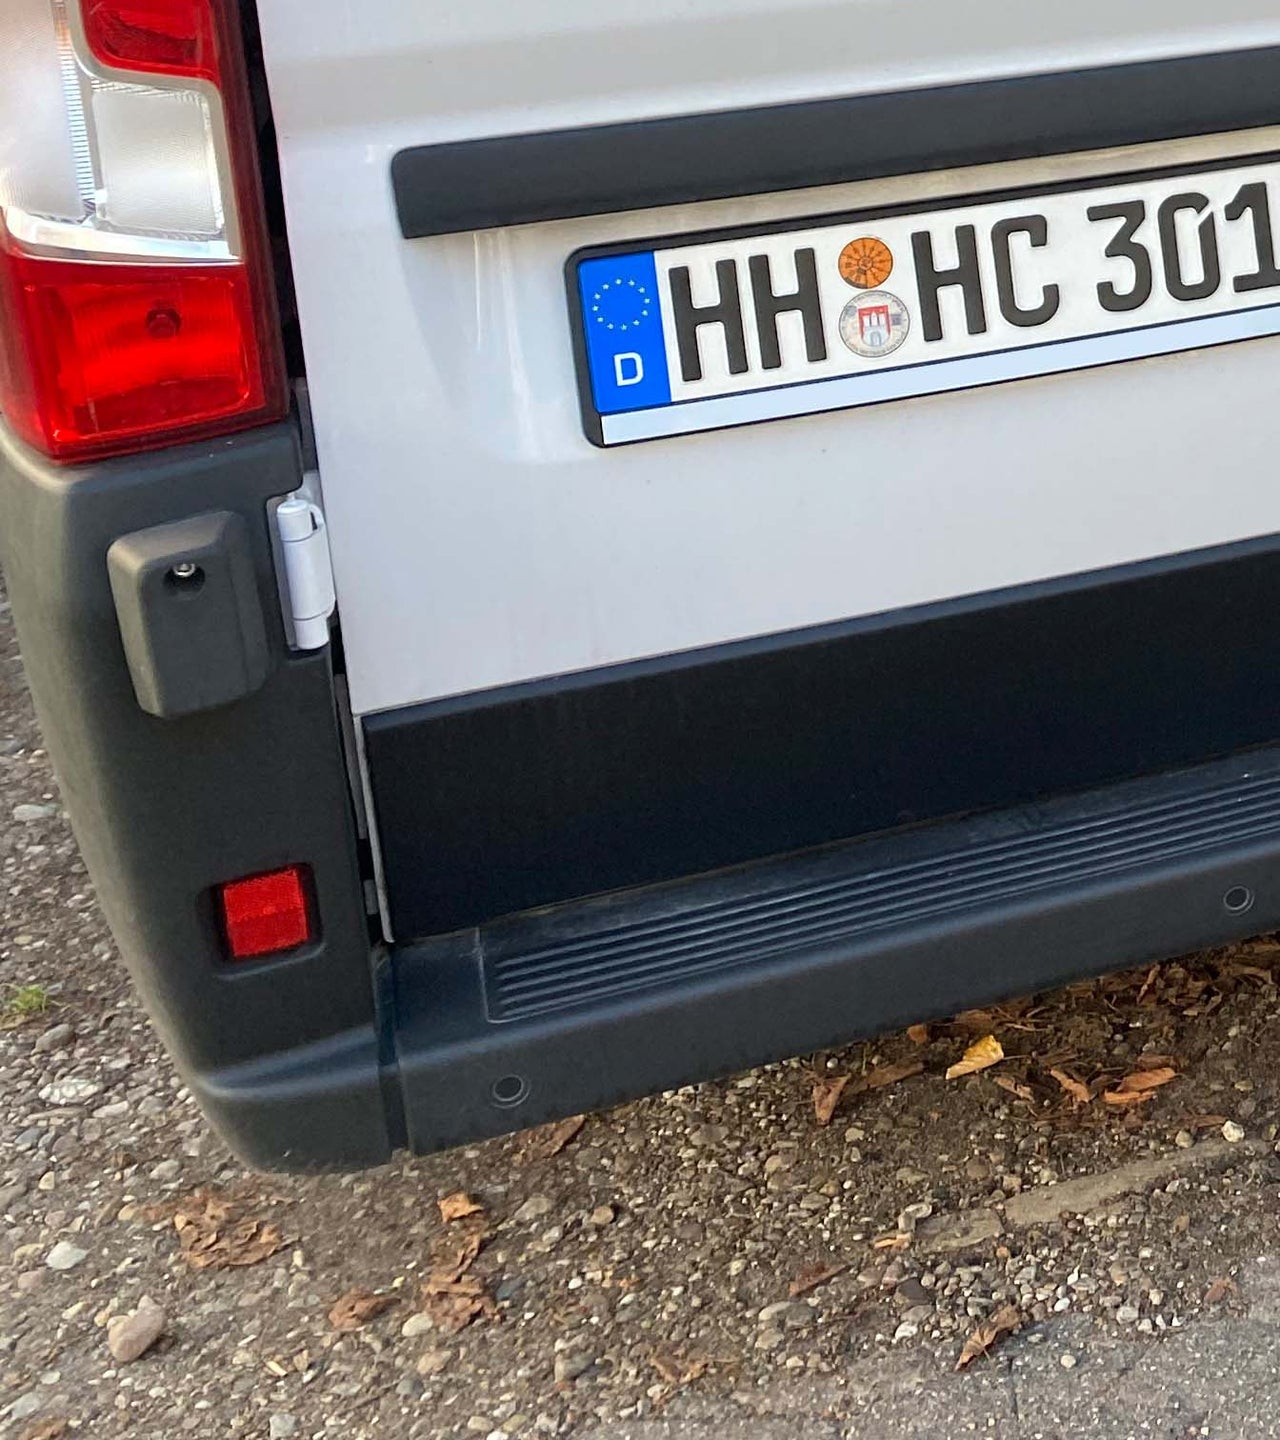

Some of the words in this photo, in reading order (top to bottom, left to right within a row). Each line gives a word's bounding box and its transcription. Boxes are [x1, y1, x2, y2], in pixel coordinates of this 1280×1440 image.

[667, 248, 829, 383] HH
[910, 214, 1061, 343] HC
[614, 350, 644, 387] D
